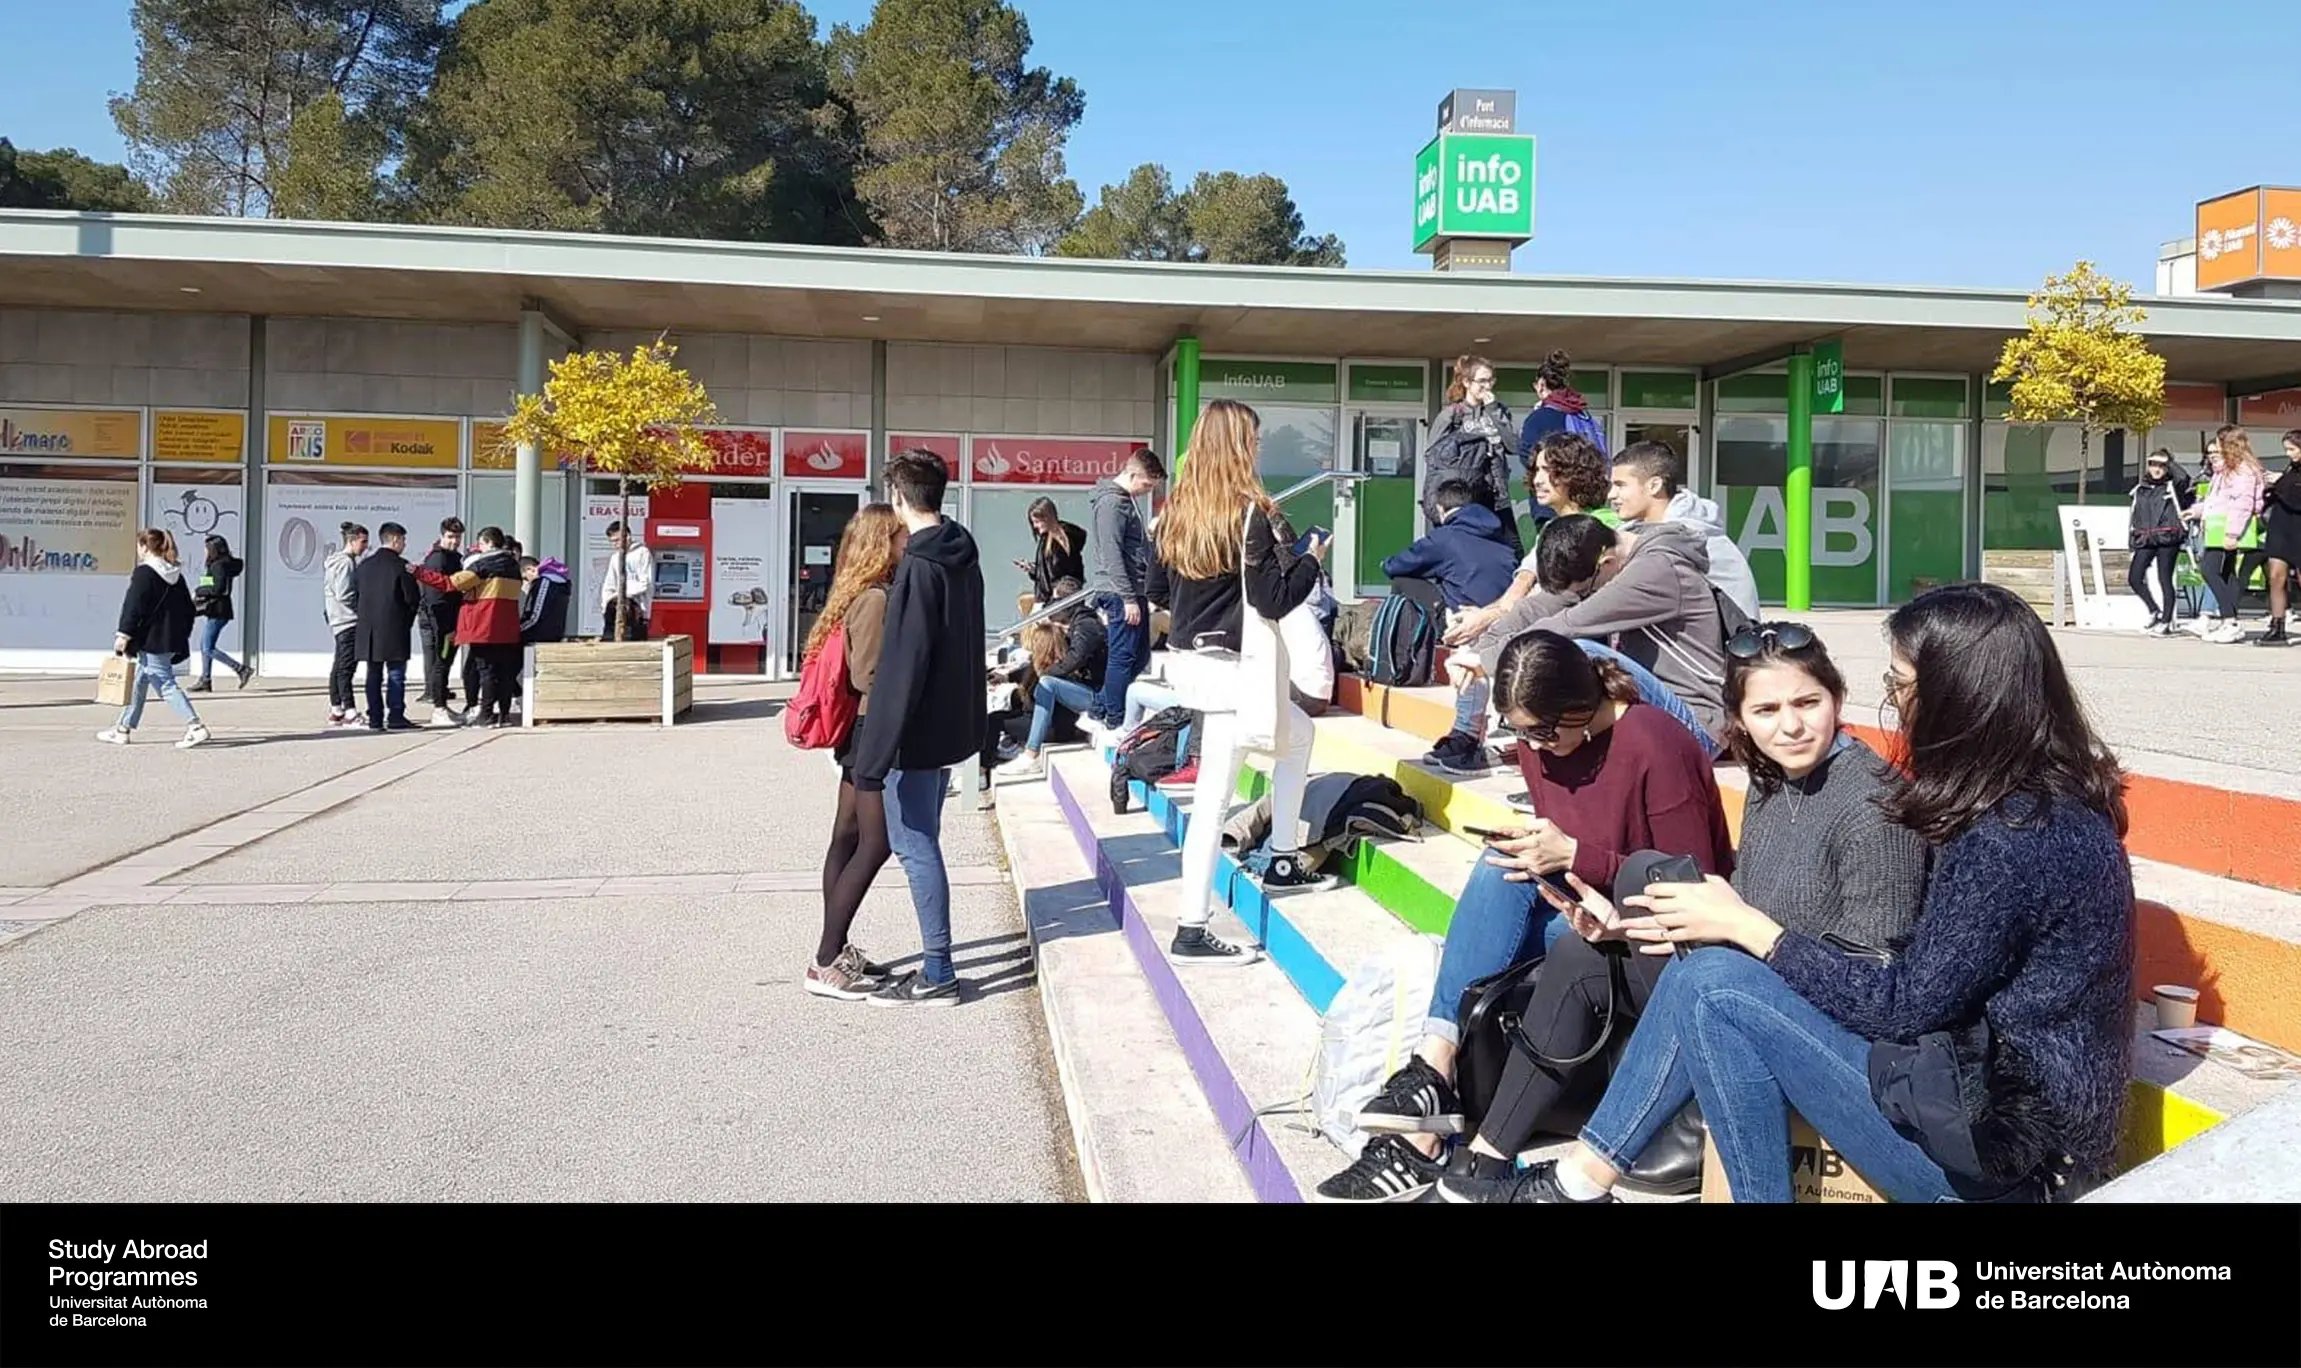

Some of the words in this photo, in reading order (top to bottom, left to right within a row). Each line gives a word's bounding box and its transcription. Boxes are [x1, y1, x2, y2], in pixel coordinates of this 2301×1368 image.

[1476, 98, 1495, 113] Punt
[1458, 153, 1521, 186] info
[1418, 191, 1437, 227] UAB
[1457, 187, 1519, 214] UAB
[1817, 358, 1838, 378] info
[1224, 372, 1286, 389] InfoUAB
[1817, 378, 1838, 395] UAB
[290, 436, 323, 458] IRIS
[391, 442, 434, 455] Kodak
[1015, 450, 1127, 475] Santand
[589, 506, 646, 517] ERASUS
[1716, 485, 1873, 566] AB
[1793, 1146, 1844, 1178] AB
[1805, 1184, 1873, 1202] Autònoma
